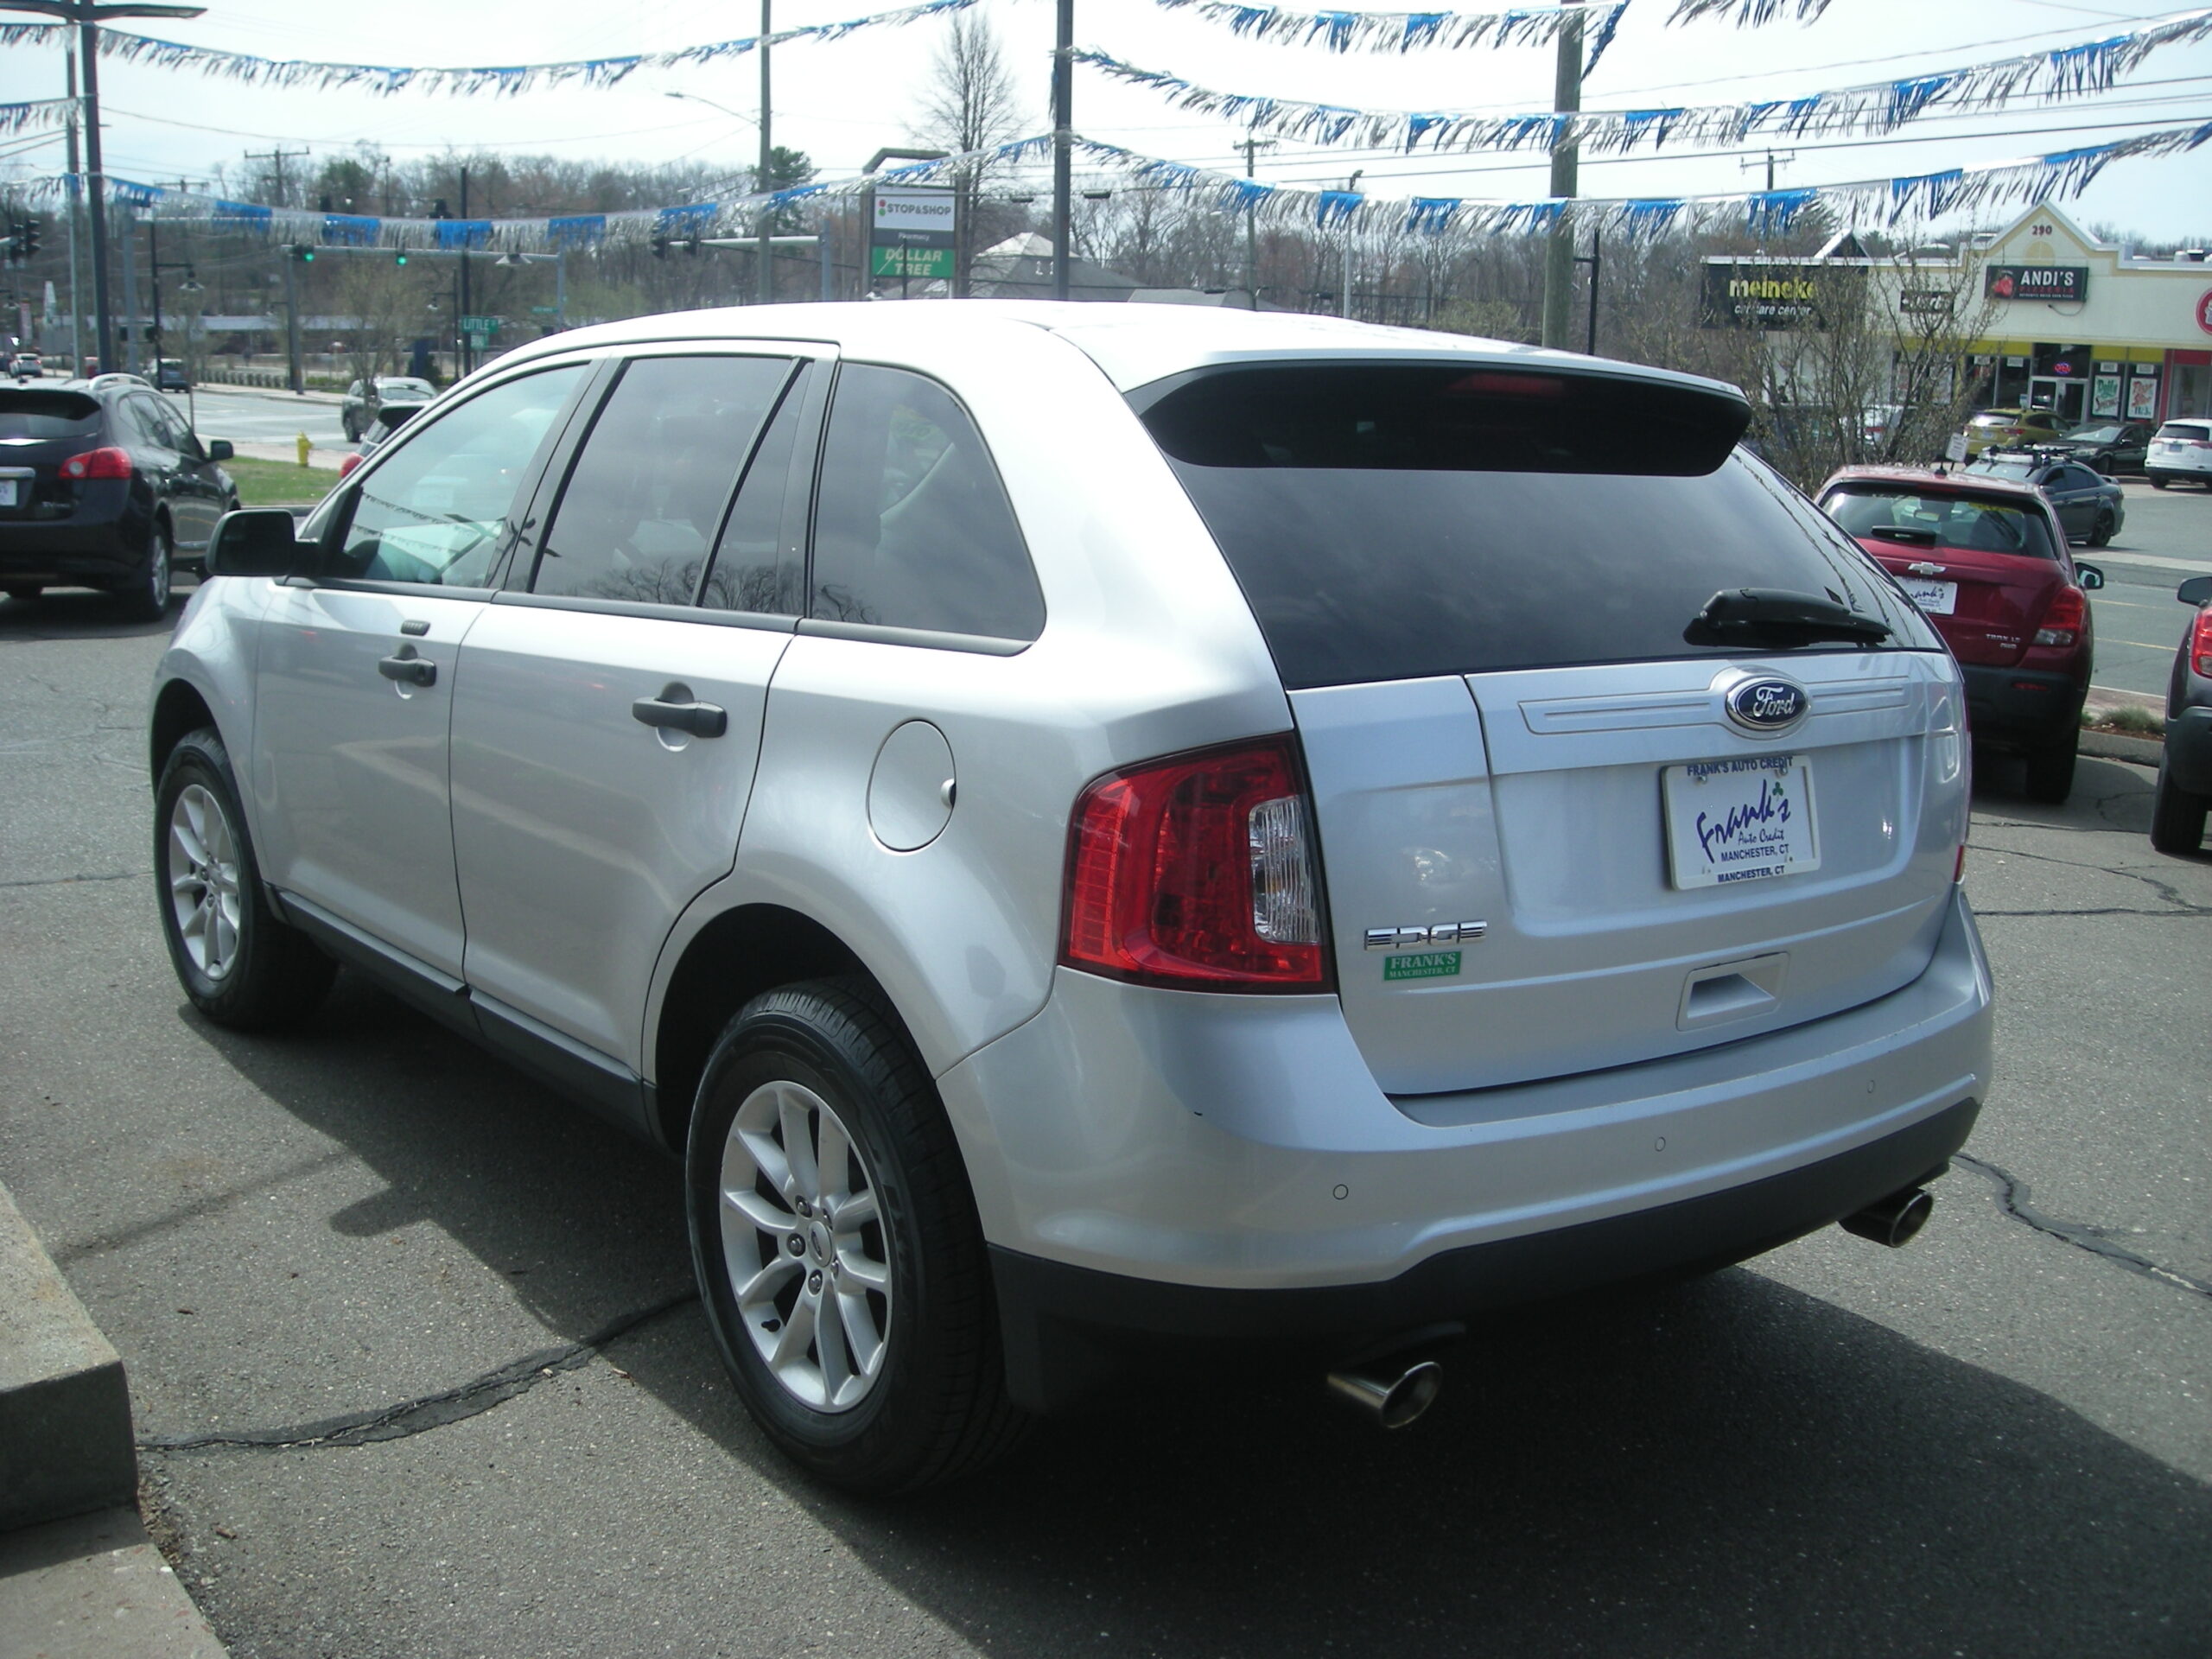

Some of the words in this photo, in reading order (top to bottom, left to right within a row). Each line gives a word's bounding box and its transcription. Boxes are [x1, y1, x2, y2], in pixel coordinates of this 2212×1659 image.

[887, 203, 951, 215] STOP&SHOP
[2031, 225, 2053, 236] 290
[885, 248, 943, 262] DOLLAR
[894, 263, 932, 276] TREE
[2020, 270, 2075, 286] ANDI'S
[463, 318, 490, 330] LITTLE
[1752, 686, 1796, 717] Ford
[1687, 762, 1729, 776] FRANK'S
[1731, 759, 1758, 772] AUTO
[1759, 756, 1794, 769] CREDIT
[1738, 831, 1758, 845] Auto
[1759, 828, 1784, 843] Credit
[1720, 846, 1777, 861] MANCHESTER,
[1779, 843, 1789, 855] CT
[1718, 867, 1773, 883] MANCHESTER,
[1774, 865, 1785, 874] CT
[1364, 919, 1488, 951] EDGE
[1390, 953, 1457, 969] FRANK'S
